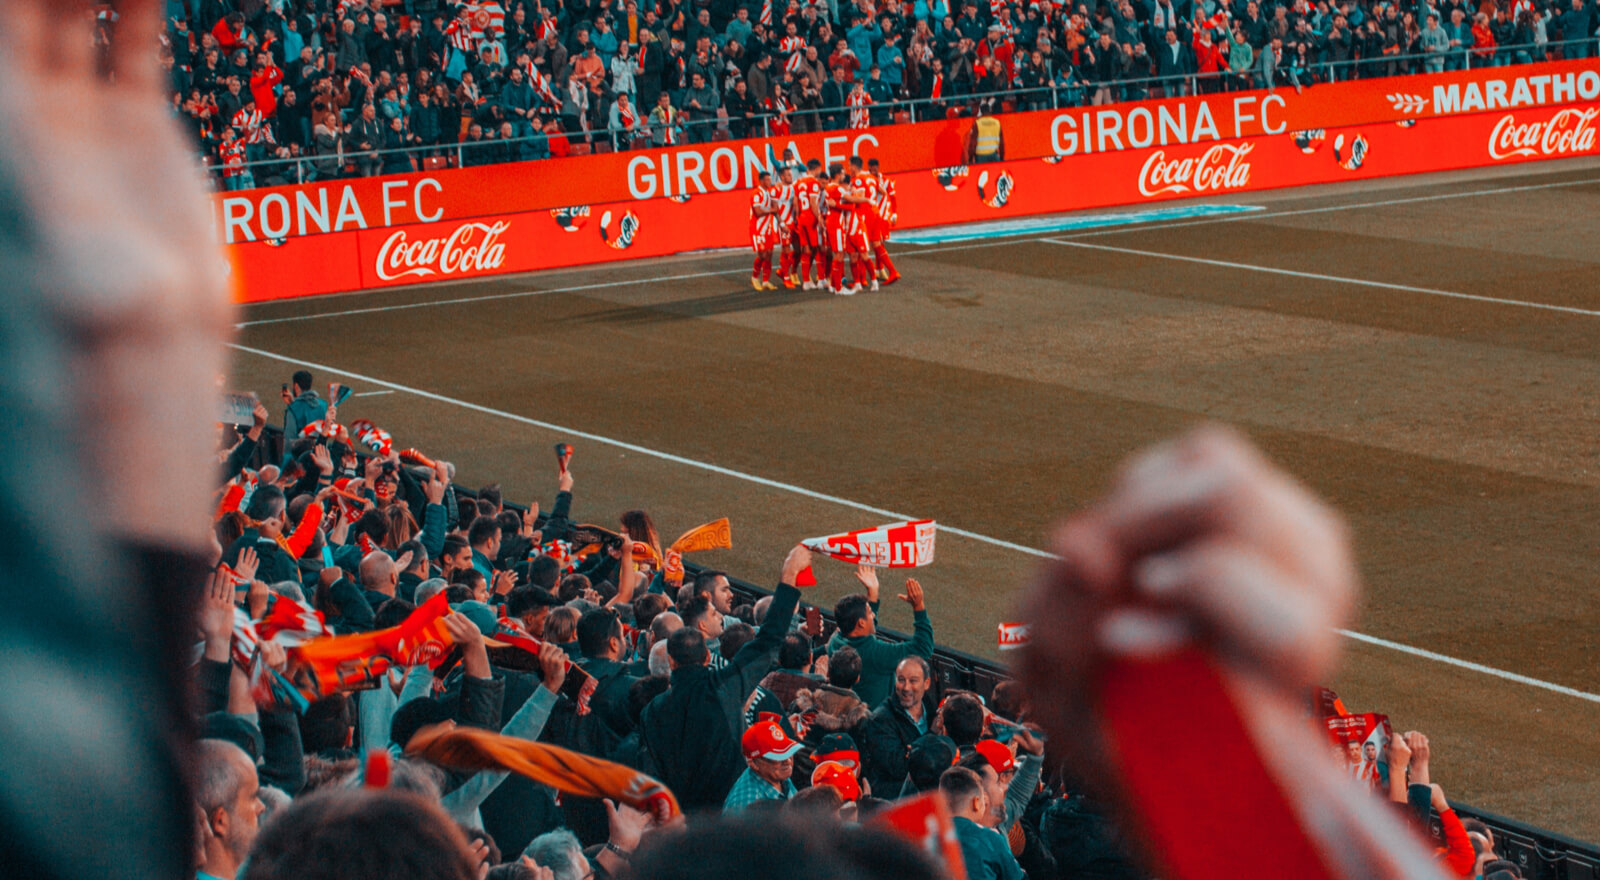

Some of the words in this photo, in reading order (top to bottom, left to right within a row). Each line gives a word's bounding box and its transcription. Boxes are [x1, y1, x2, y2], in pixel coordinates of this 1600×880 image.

[1050, 100, 1221, 156] GIRONA
[1233, 94, 1287, 139] FC
[1488, 107, 1600, 159] Coca-Cola
[1138, 142, 1255, 197] Coca-Cola
[223, 184, 369, 244] RONA
[382, 178, 443, 227] FC
[376, 220, 511, 281] Coca-Cola
